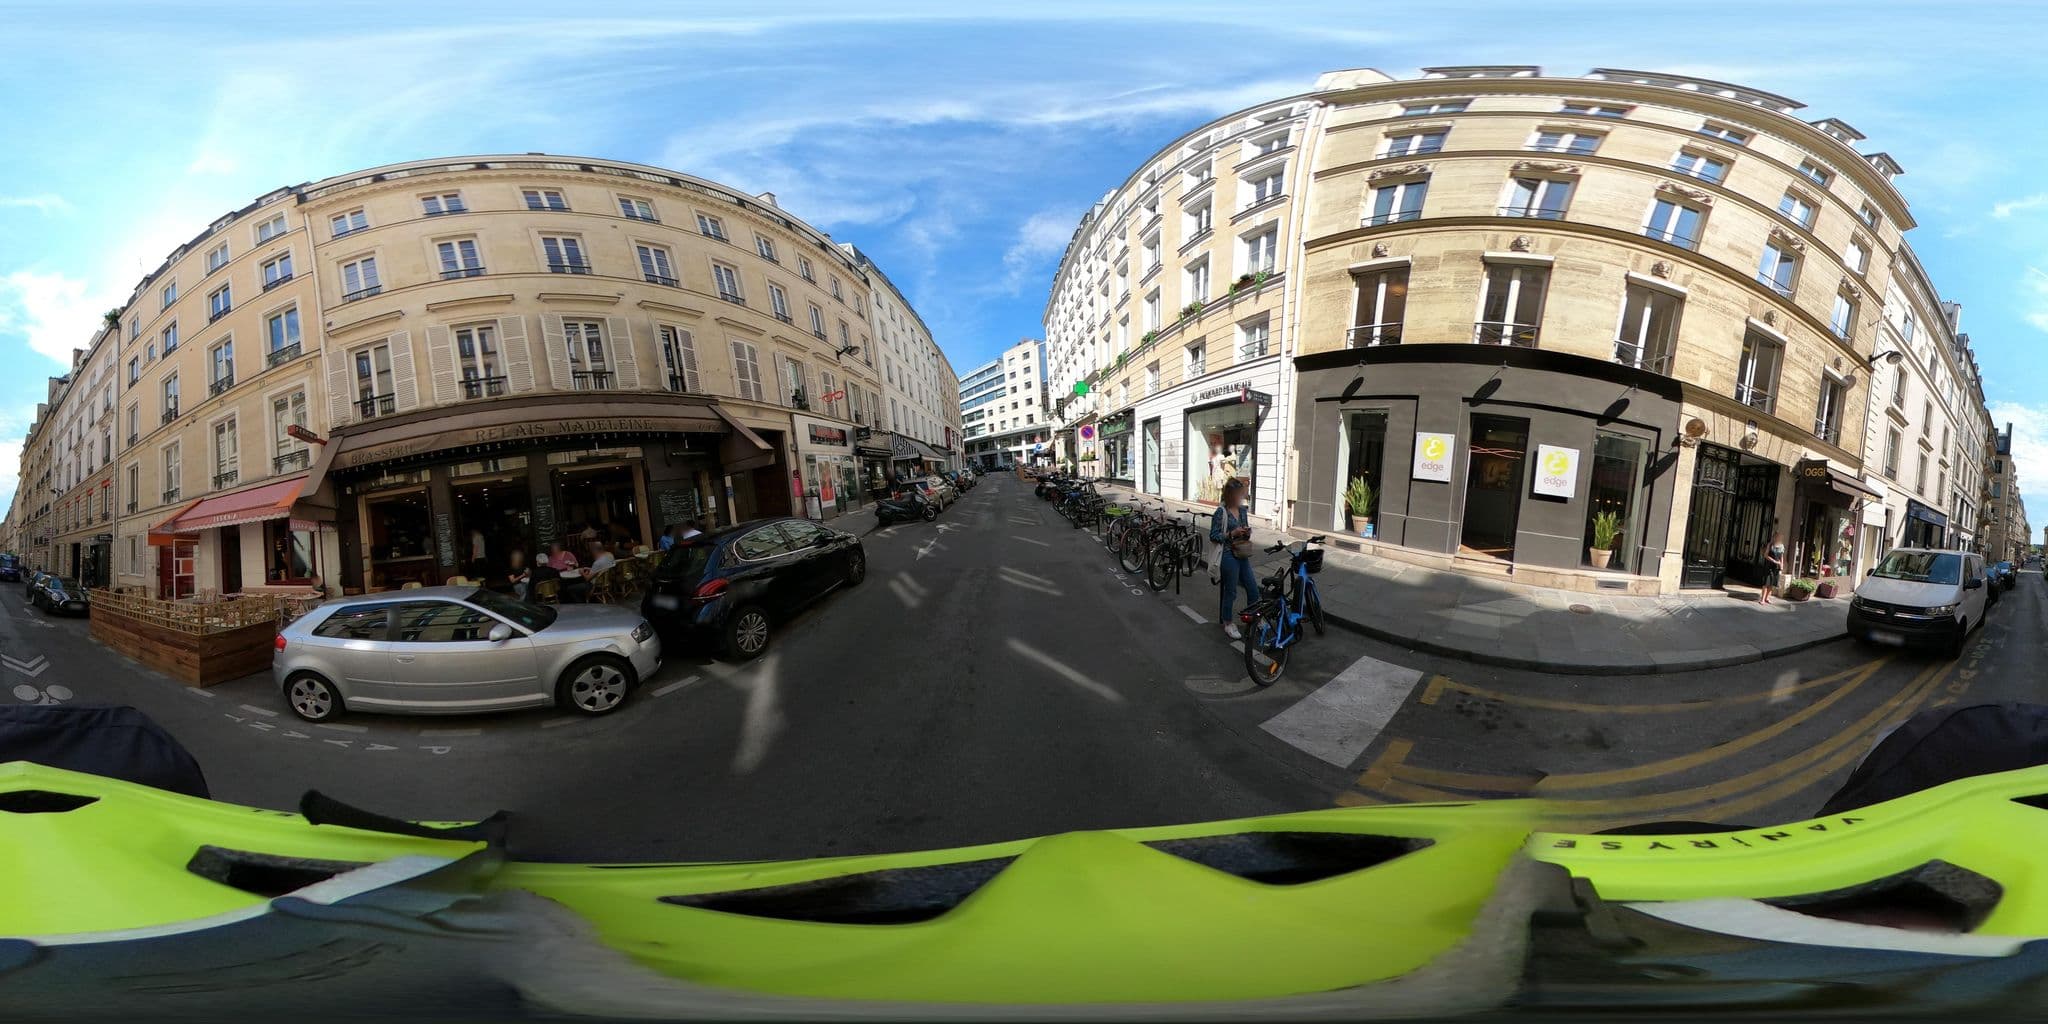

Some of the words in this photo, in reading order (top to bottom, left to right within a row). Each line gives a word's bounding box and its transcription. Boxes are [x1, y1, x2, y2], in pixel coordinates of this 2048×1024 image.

[474, 423, 546, 442] RELAIS
[558, 419, 654, 434] MADELEINE
[1421, 462, 1445, 472] edge
[1805, 467, 1826, 477] OGGI
[1543, 476, 1568, 487] edge
[224, 713, 452, 755] PAYANT
